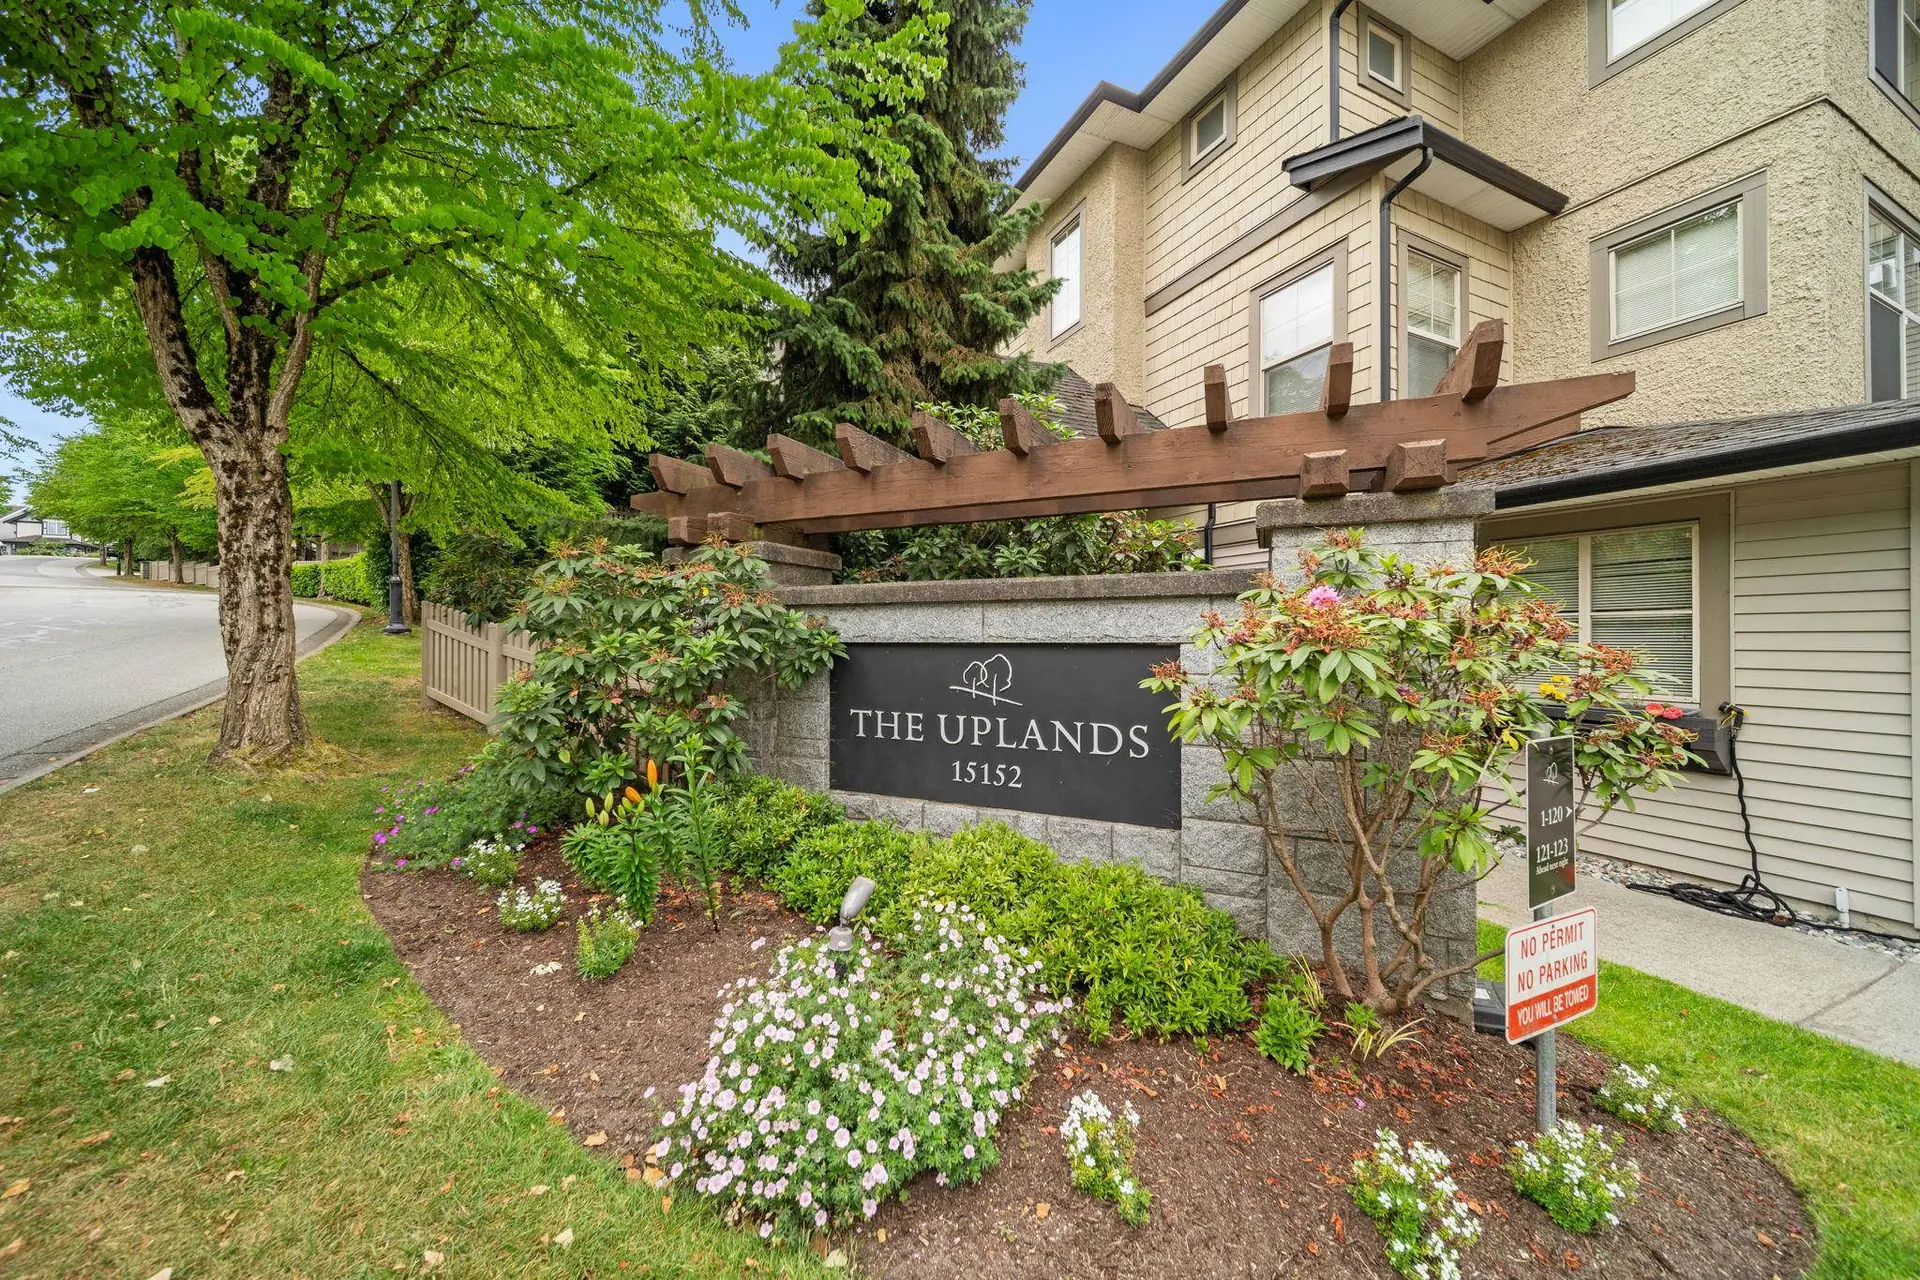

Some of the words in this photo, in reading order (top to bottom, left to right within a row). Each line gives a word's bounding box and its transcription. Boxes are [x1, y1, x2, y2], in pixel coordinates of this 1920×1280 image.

[850, 708, 924, 742] THE
[937, 714, 1150, 759] UPLANDS
[951, 761, 1022, 788] 15152
[1540, 805, 1563, 827] 1-120
[1535, 837, 1568, 863] 121-123
[1521, 936, 1537, 959] NO
[1542, 921, 1584, 952] PERMIT
[1518, 969, 1533, 993] NO
[1540, 950, 1588, 985] PARKING
[1517, 1006, 1533, 1027] YOU
[1534, 998, 1552, 1018] WILL
[1553, 992, 1564, 1011] BE
[1565, 984, 1588, 1006] TOWED
